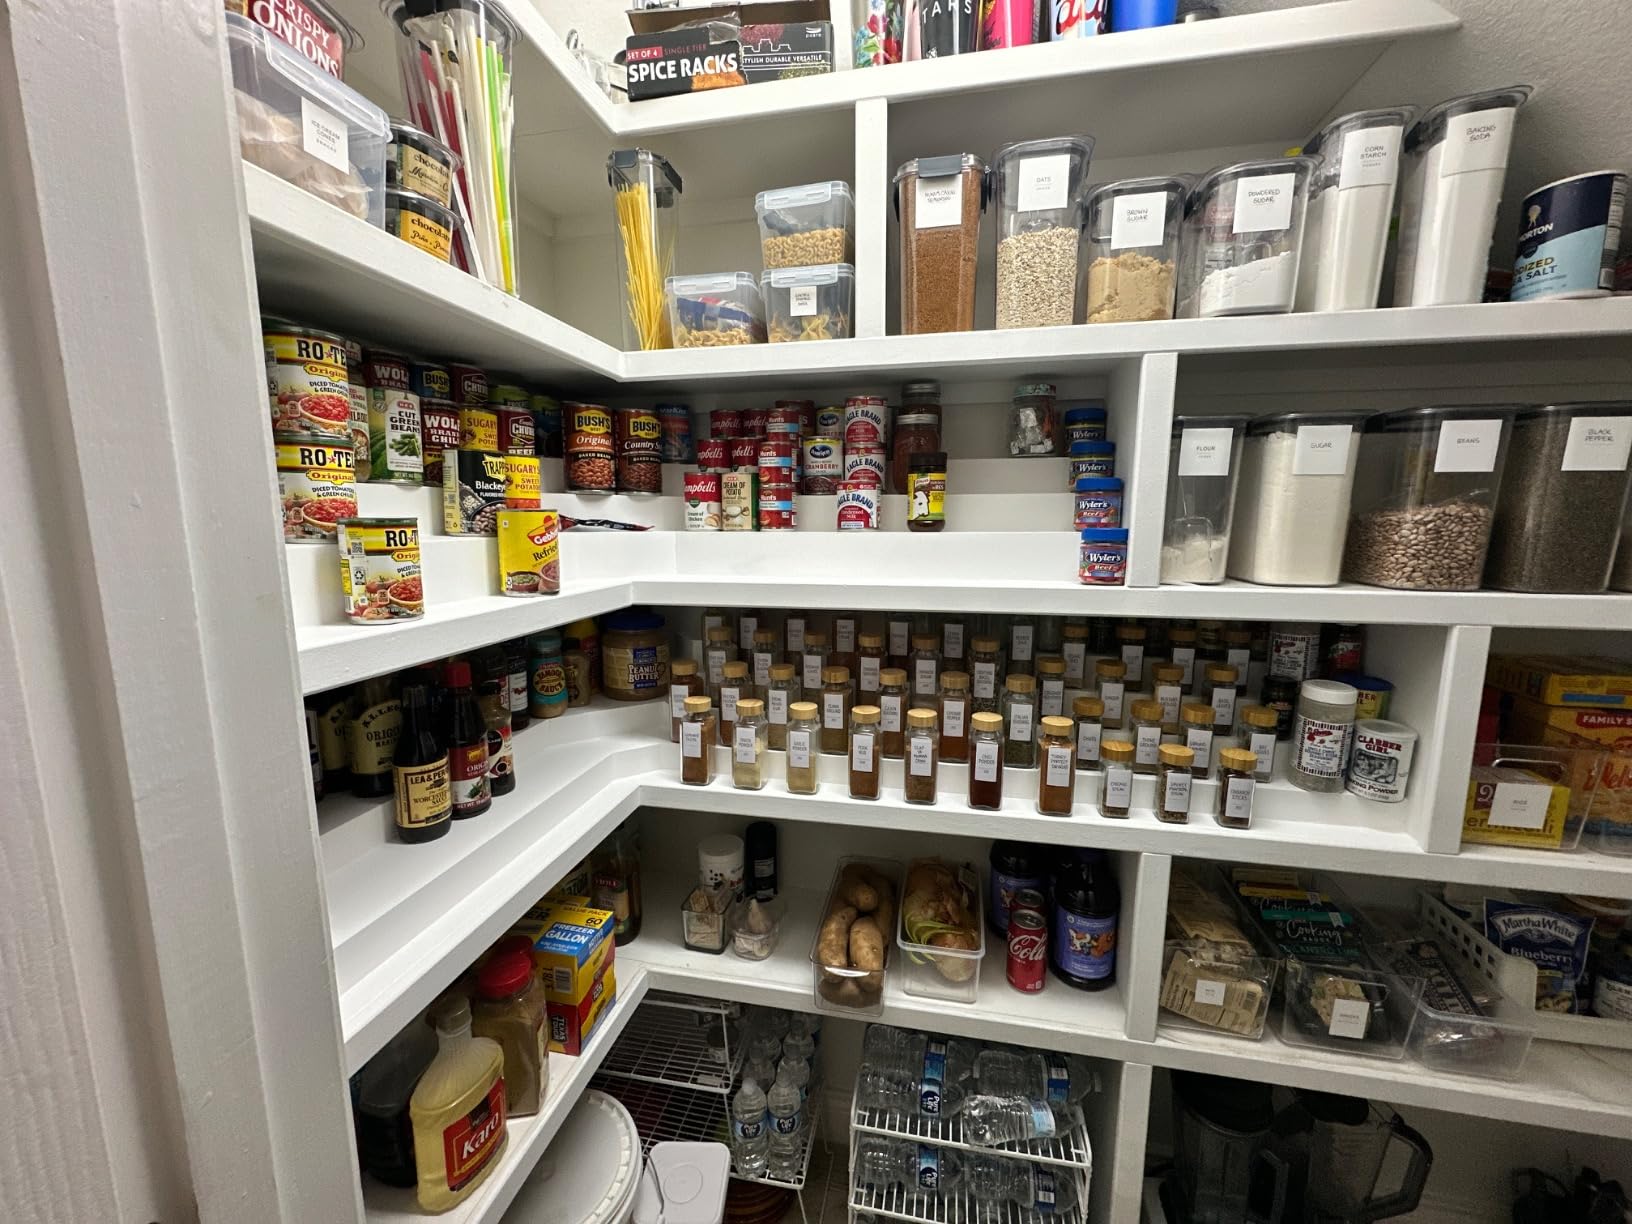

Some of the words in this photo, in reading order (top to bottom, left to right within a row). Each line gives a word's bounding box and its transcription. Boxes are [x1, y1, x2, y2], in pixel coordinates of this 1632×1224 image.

[252, 0, 339, 78] ONIONS
[627, 51, 639, 60] SET
[641, 50, 650, 58] OF
[652, 49, 658, 57] 4
[765, 55, 791, 63] DURABLE
[793, 54, 823, 62] VERSATILE
[629, 59, 677, 83] SPICE
[681, 53, 737, 77] RACKS
[1466, 125, 1496, 135] BAKING
[1469, 134, 1490, 142] SODA
[1360, 151, 1386, 159] STARCH
[414, 152, 450, 179] chocolat
[1248, 188, 1281, 198] POWDERED
[411, 217, 451, 242] chocolat
[1519, 223, 1554, 241] ORTON
[1526, 264, 1558, 280] SALT
[374, 364, 408, 379] WOL
[424, 373, 449, 387] BUSH
[398, 410, 417, 419] CUT
[861, 408, 881, 425] BRAND
[577, 416, 610, 428] BUSH'S
[431, 435, 460, 444] CHIL
[478, 438, 496, 446] POTAT
[576, 435, 612, 446] Original
[624, 440, 655, 451] Country
[484, 460, 505, 476] TRAPP
[505, 464, 536, 475] SUGARY
[865, 458, 884, 473] BRAND
[1079, 463, 1107, 473] Wyler's
[476, 481, 505, 492] Blackey
[685, 480, 716, 493] ampbell's
[838, 493, 851, 506] AGLE
[852, 493, 874, 509] BRAND
[1079, 500, 1108, 510] Wyler's
[1089, 553, 1121, 563] Wyler's
[628, 663, 658, 674] PEANUT
[629, 672, 659, 683] BUTTER
[362, 704, 401, 728] ALLEG
[1583, 715, 1623, 724] FAMILY
[1357, 735, 1402, 752] CLABBER
[1365, 743, 1389, 754] GIRL
[411, 774, 425, 784] LEA
[426, 774, 433, 782] &
[1368, 784, 1399, 794] POWDER
[563, 906, 587, 914] VALUE
[588, 909, 609, 917] PACK
[586, 917, 602, 925] 60
[553, 923, 594, 935] FREEZER
[1502, 916, 1541, 932] Martha
[1541, 917, 1576, 938] White
[545, 931, 589, 945] GALLON
[1010, 935, 1047, 961] Cola
[462, 1111, 499, 1159] Karo
